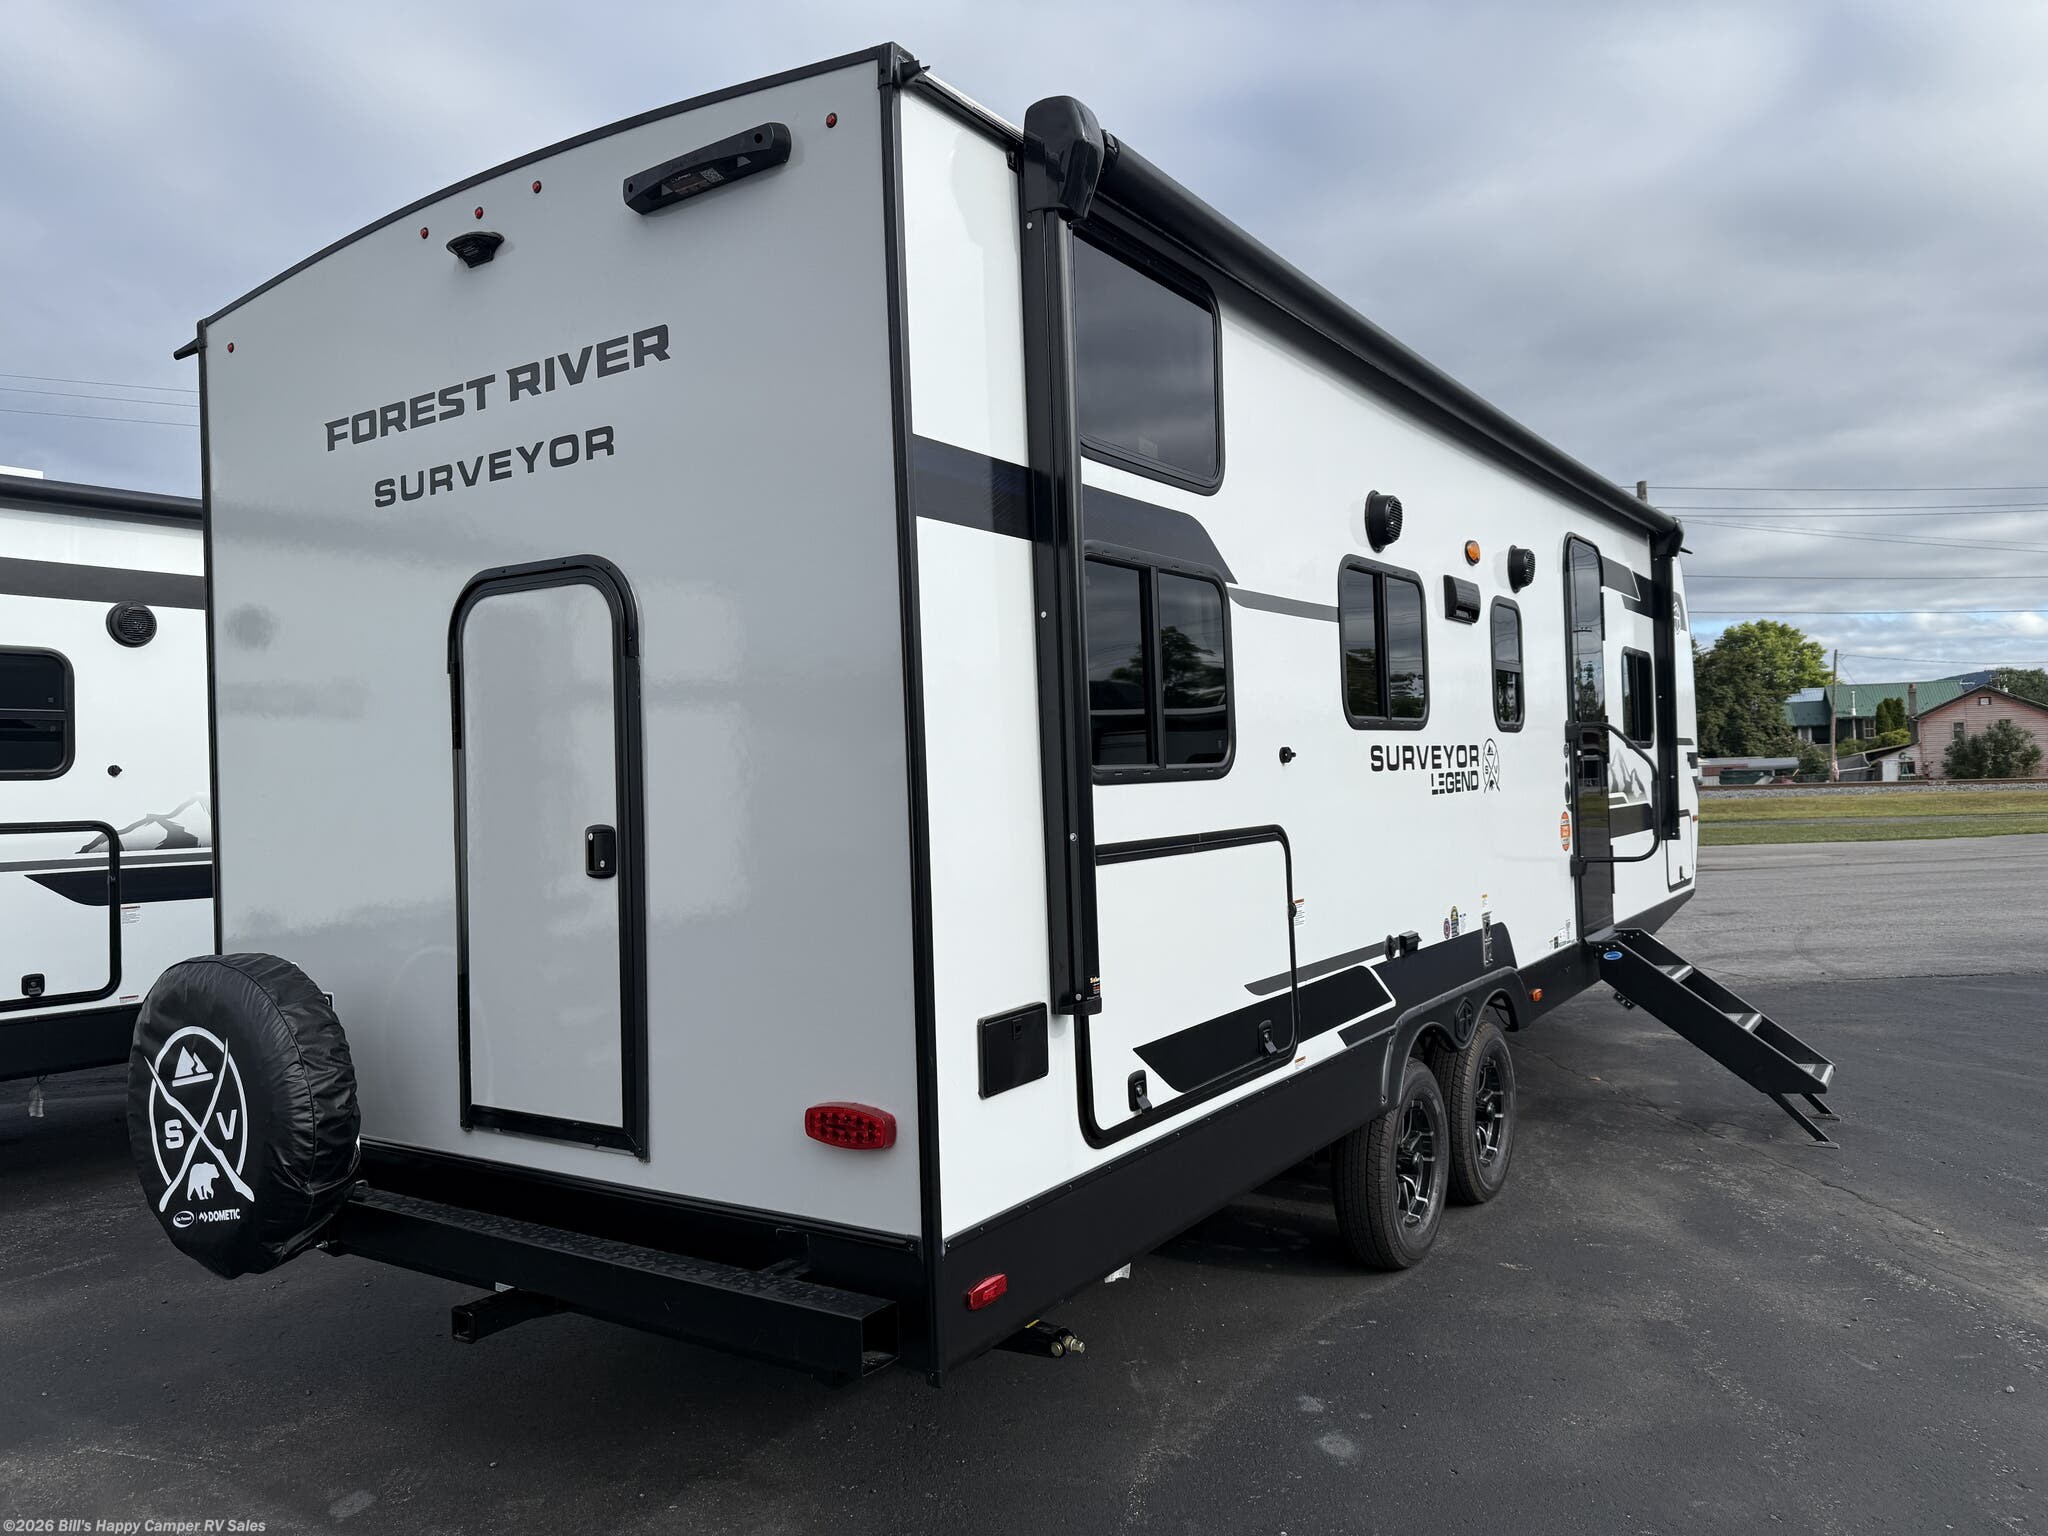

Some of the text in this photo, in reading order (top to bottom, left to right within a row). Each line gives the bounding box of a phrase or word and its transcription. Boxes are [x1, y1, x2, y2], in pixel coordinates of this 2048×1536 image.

[324, 323, 671, 452] FOREST RIVER
[374, 425, 615, 508] SURVEYOR
[1370, 744, 1480, 772] SURVEYOR
[1431, 770, 1479, 795] LEGEND
[164, 1109, 238, 1149] S V
[208, 1208, 241, 1222] DOMETIC
